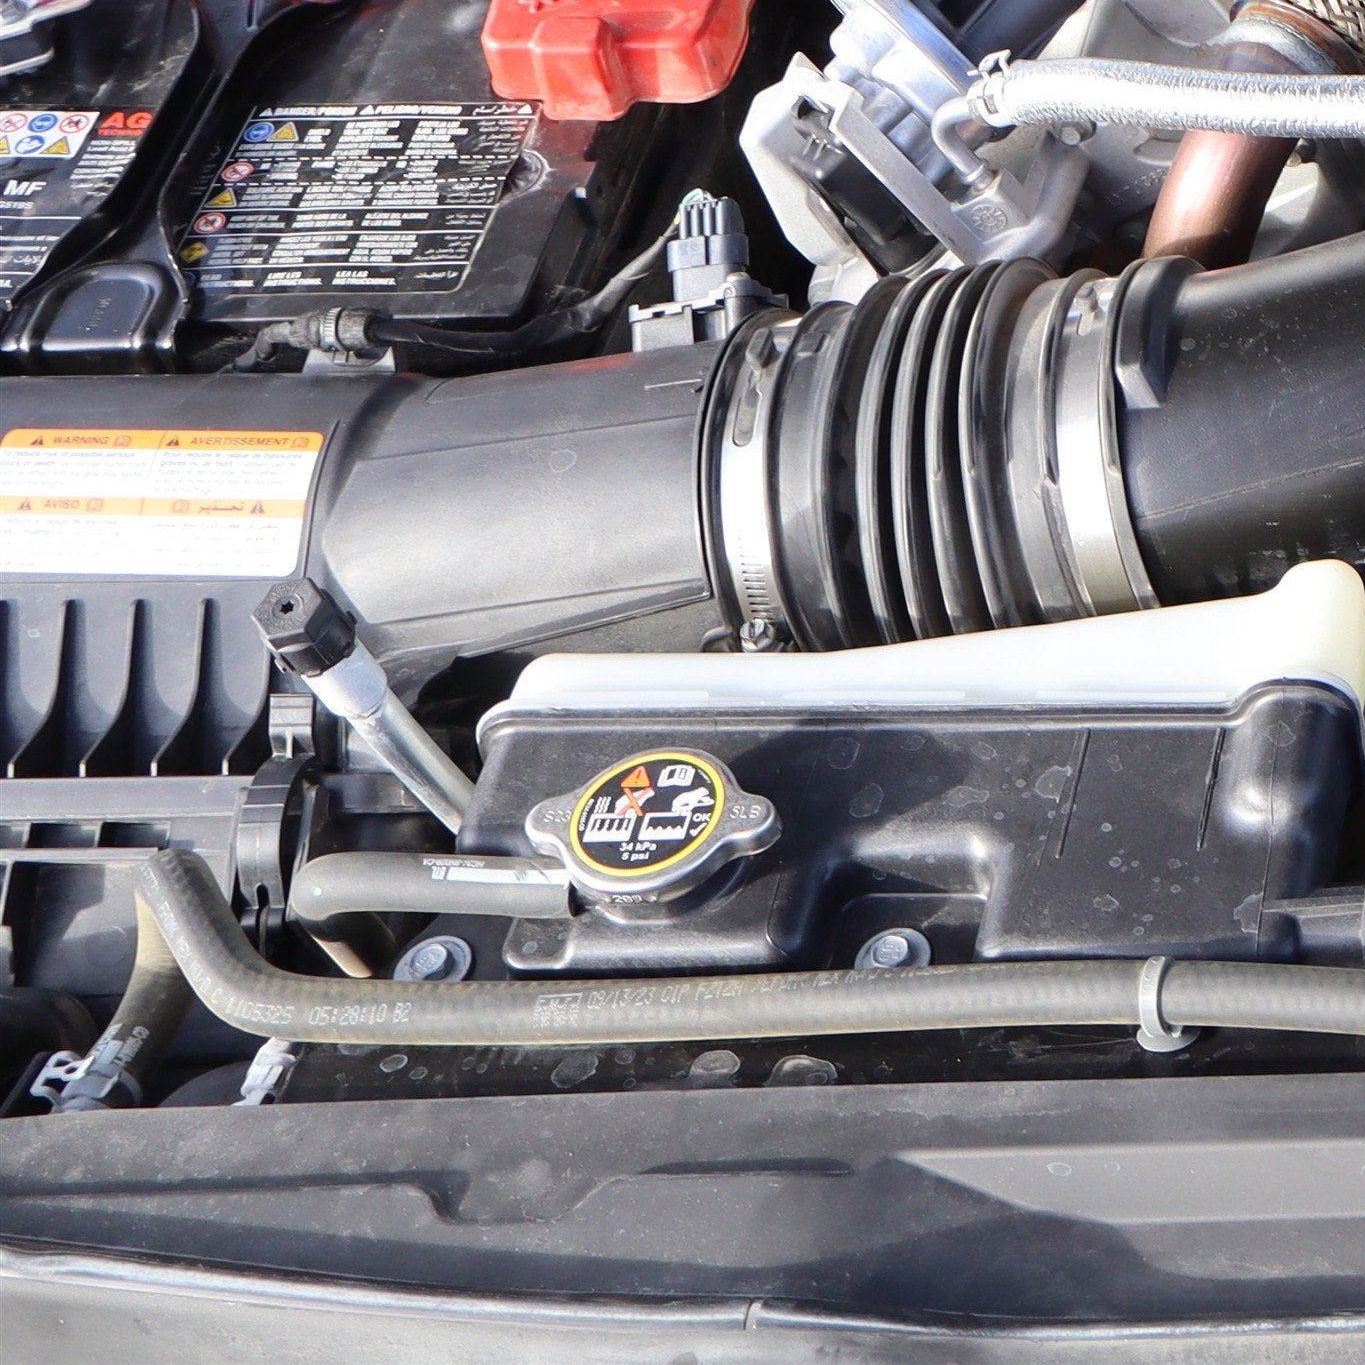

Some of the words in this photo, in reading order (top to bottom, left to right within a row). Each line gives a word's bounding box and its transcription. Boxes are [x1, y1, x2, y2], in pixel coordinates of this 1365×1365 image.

[101, 111, 153, 129] AG
[3, 179, 47, 196] MF
[52, 436, 110, 446] WARNING
[189, 436, 291, 446] AVERTISSEMENT
[43, 499, 81, 510] AVISO
[692, 812, 712, 823] OK
[619, 841, 634, 852] 34
[635, 840, 657, 852] kPa
[622, 852, 630, 861] 5
[631, 851, 651, 863] psi
[586, 985, 656, 1010] 09/13/23
[307, 1002, 387, 1026] 05:28:10
